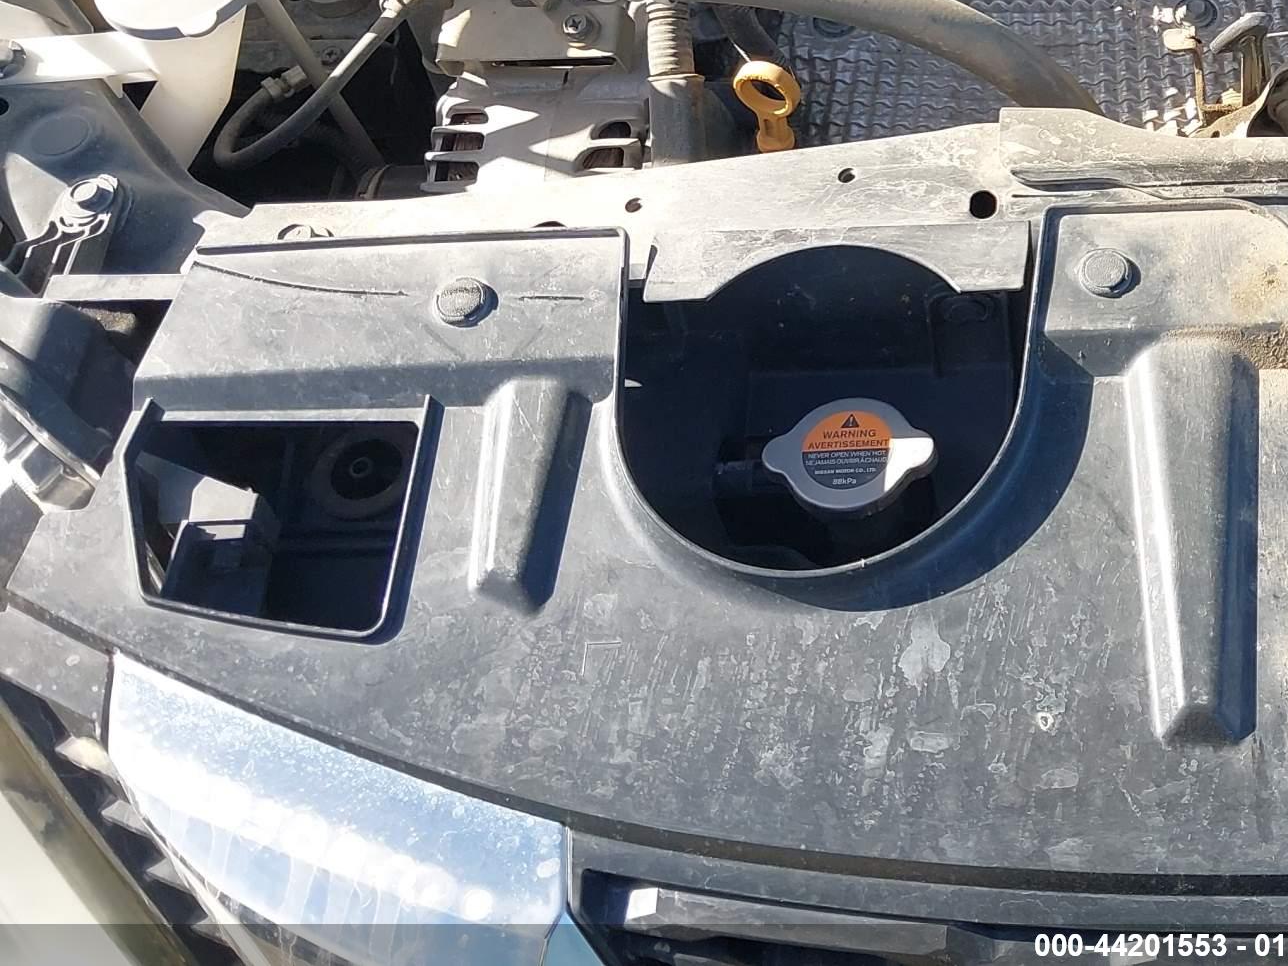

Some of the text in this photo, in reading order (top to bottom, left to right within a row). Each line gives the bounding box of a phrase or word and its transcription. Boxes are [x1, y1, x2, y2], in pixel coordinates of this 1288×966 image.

[823, 429, 877, 440] WARNING
[808, 438, 889, 450] AVERTISSEMENT
[832, 477, 857, 485] 88kPa
